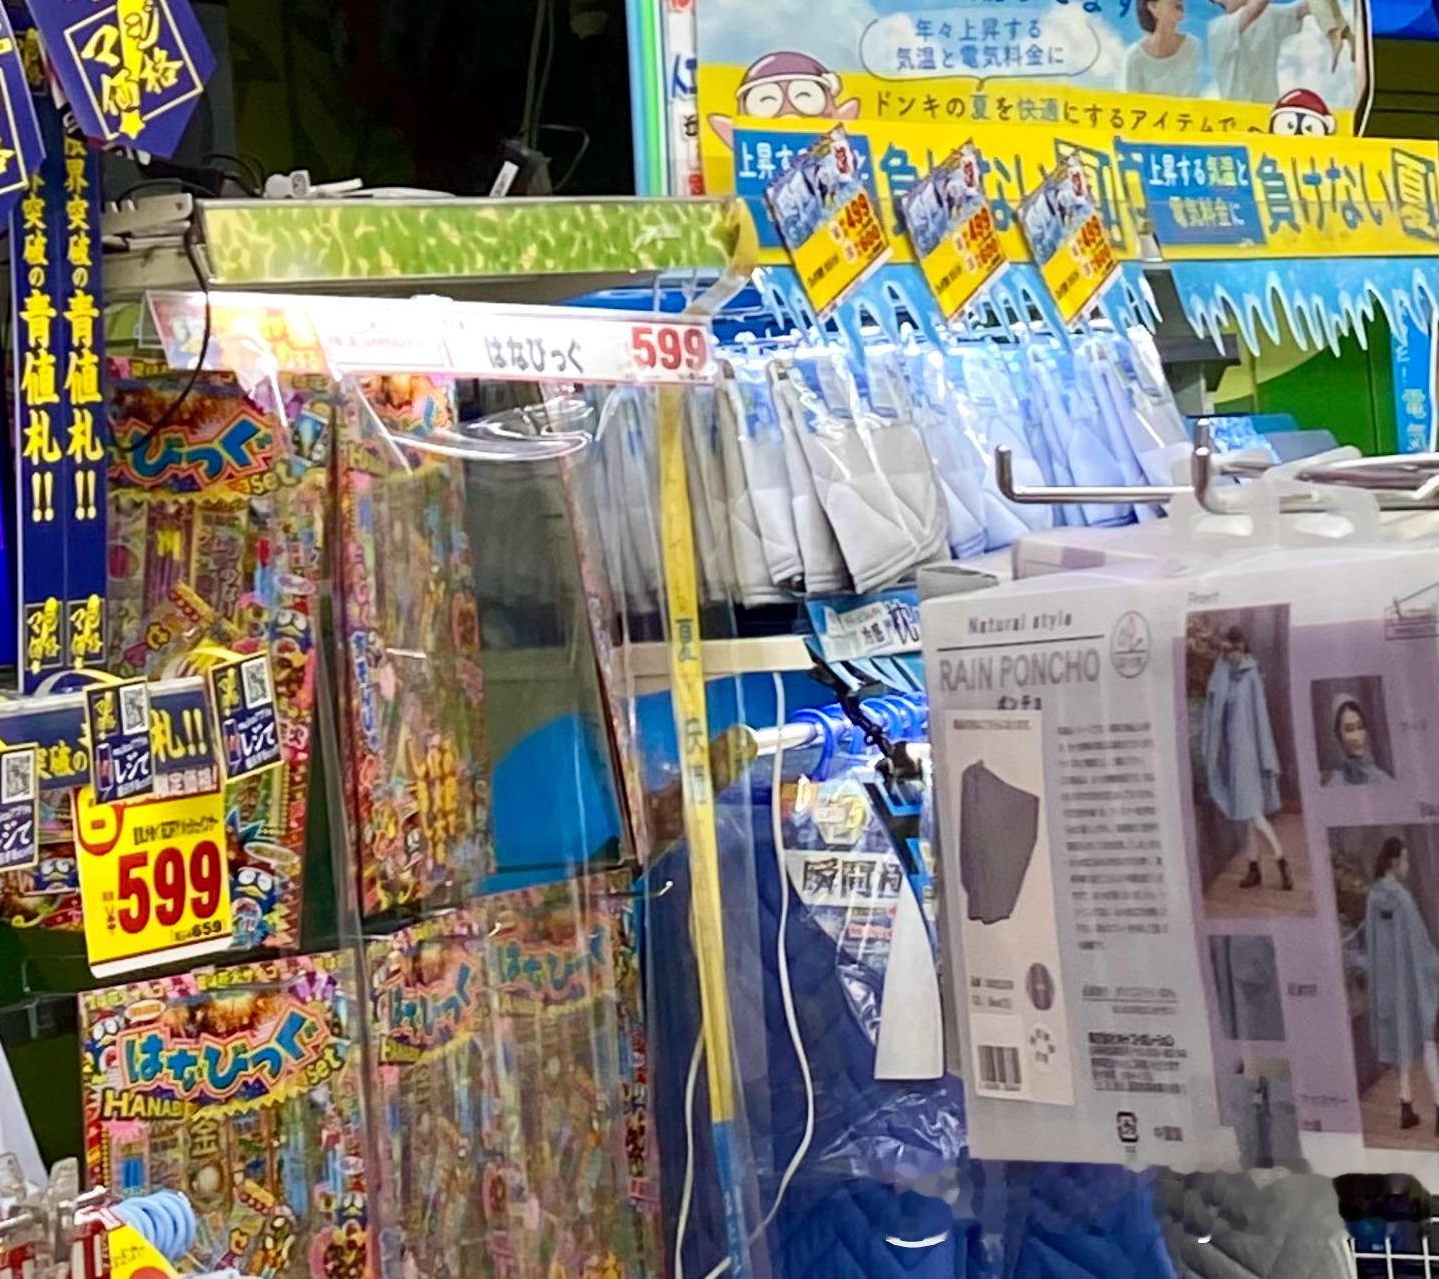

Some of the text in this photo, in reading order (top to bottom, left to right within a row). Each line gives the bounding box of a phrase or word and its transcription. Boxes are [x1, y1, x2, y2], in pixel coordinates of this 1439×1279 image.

[914, 16, 1044, 42] 年々上昇する
[895, 44, 1065, 71] 気温と電気料金に
[873, 89, 1263, 134] ドンキの夏を快適にするアイテムで
[1148, 154, 1250, 190] 上昇する気温と
[629, 326, 708, 372] 599
[968, 610, 1073, 634] Natural style
[939, 647, 1101, 692] RAIN PONCHO
[117, 839, 223, 935] 599
[123, 1007, 320, 1093] はなびっぐ
